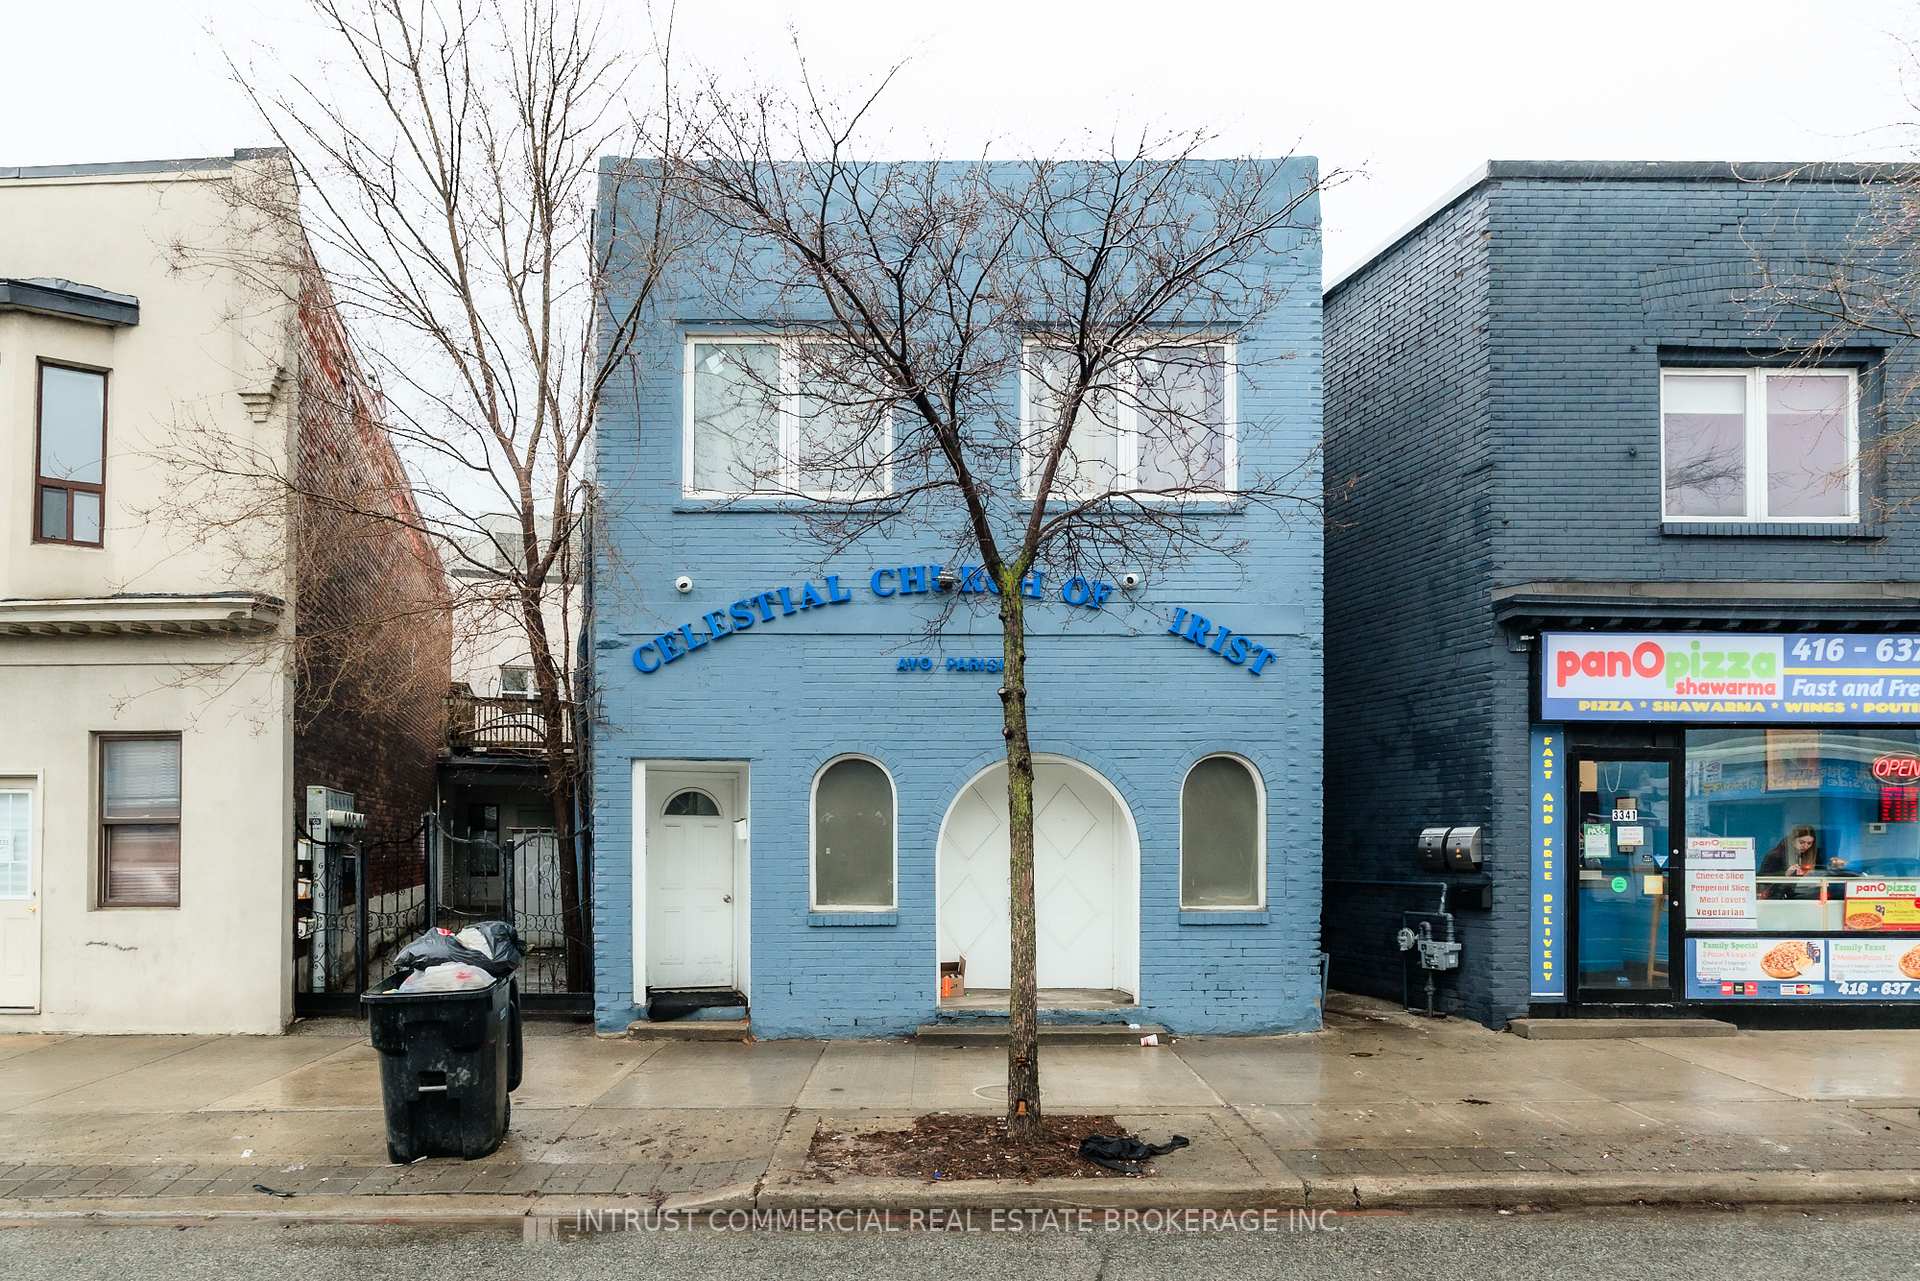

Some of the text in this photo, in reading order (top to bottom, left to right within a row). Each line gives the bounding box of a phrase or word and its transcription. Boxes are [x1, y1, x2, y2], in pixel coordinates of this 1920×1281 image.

[632, 575, 852, 674] CELESTIAL
[1062, 576, 1113, 610] OF
[1167, 606, 1277, 677] IRIST
[1791, 637, 1845, 662] 416
[896, 656, 933, 672] AVO
[1675, 677, 1777, 696] shawarma
[1792, 678, 1838, 697] Fast
[1842, 678, 1885, 697] and
[1578, 700, 1634, 712] PIZZA
[1652, 700, 1766, 713] SHAWARMA
[1784, 702, 1846, 713] WINGS
[1876, 759, 1920, 776] OPEN
[1613, 811, 1636, 819] 3341
[1543, 737, 1554, 981] FAST AND FREE DELIVERY
[1731, 884, 1750, 892] Slice
[1696, 908, 1745, 917] Vegetarian
[1703, 942, 1728, 950] Family
[1838, 982, 1868, 995] 416
[1881, 982, 1911, 995] 637
